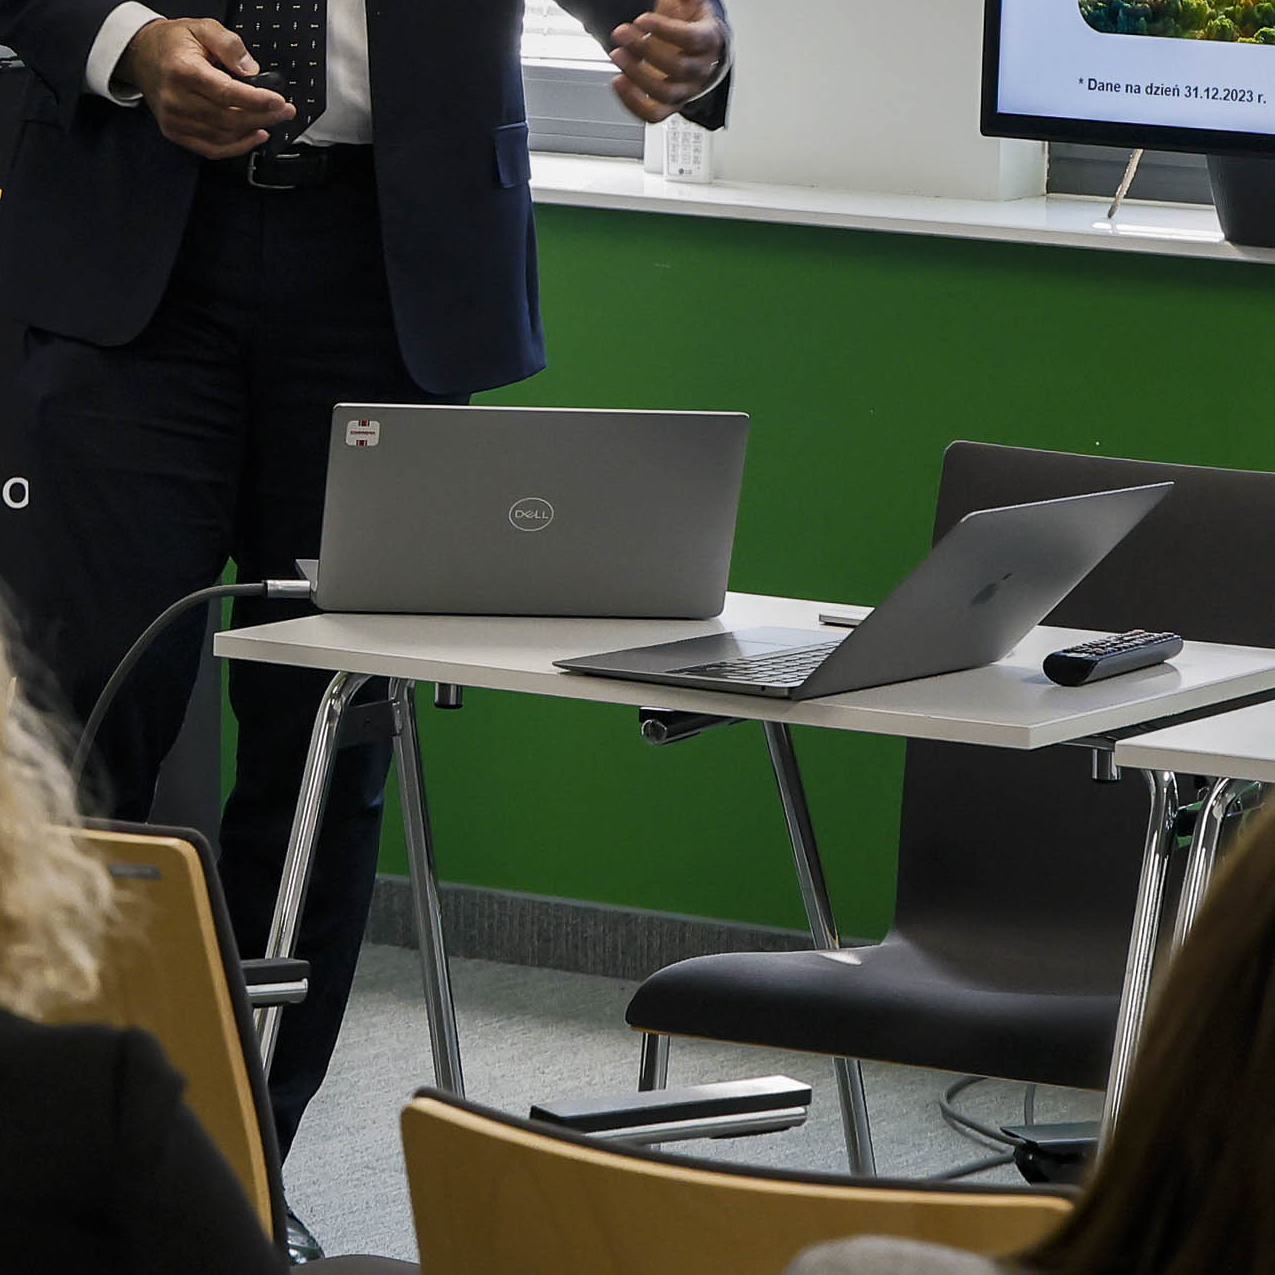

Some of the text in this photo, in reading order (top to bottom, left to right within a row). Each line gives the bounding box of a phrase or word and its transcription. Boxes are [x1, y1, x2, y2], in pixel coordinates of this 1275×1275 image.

[1087, 77, 1267, 105] Dane na dzień 31.12.2023 r.
[514, 509, 549, 520] DELL
